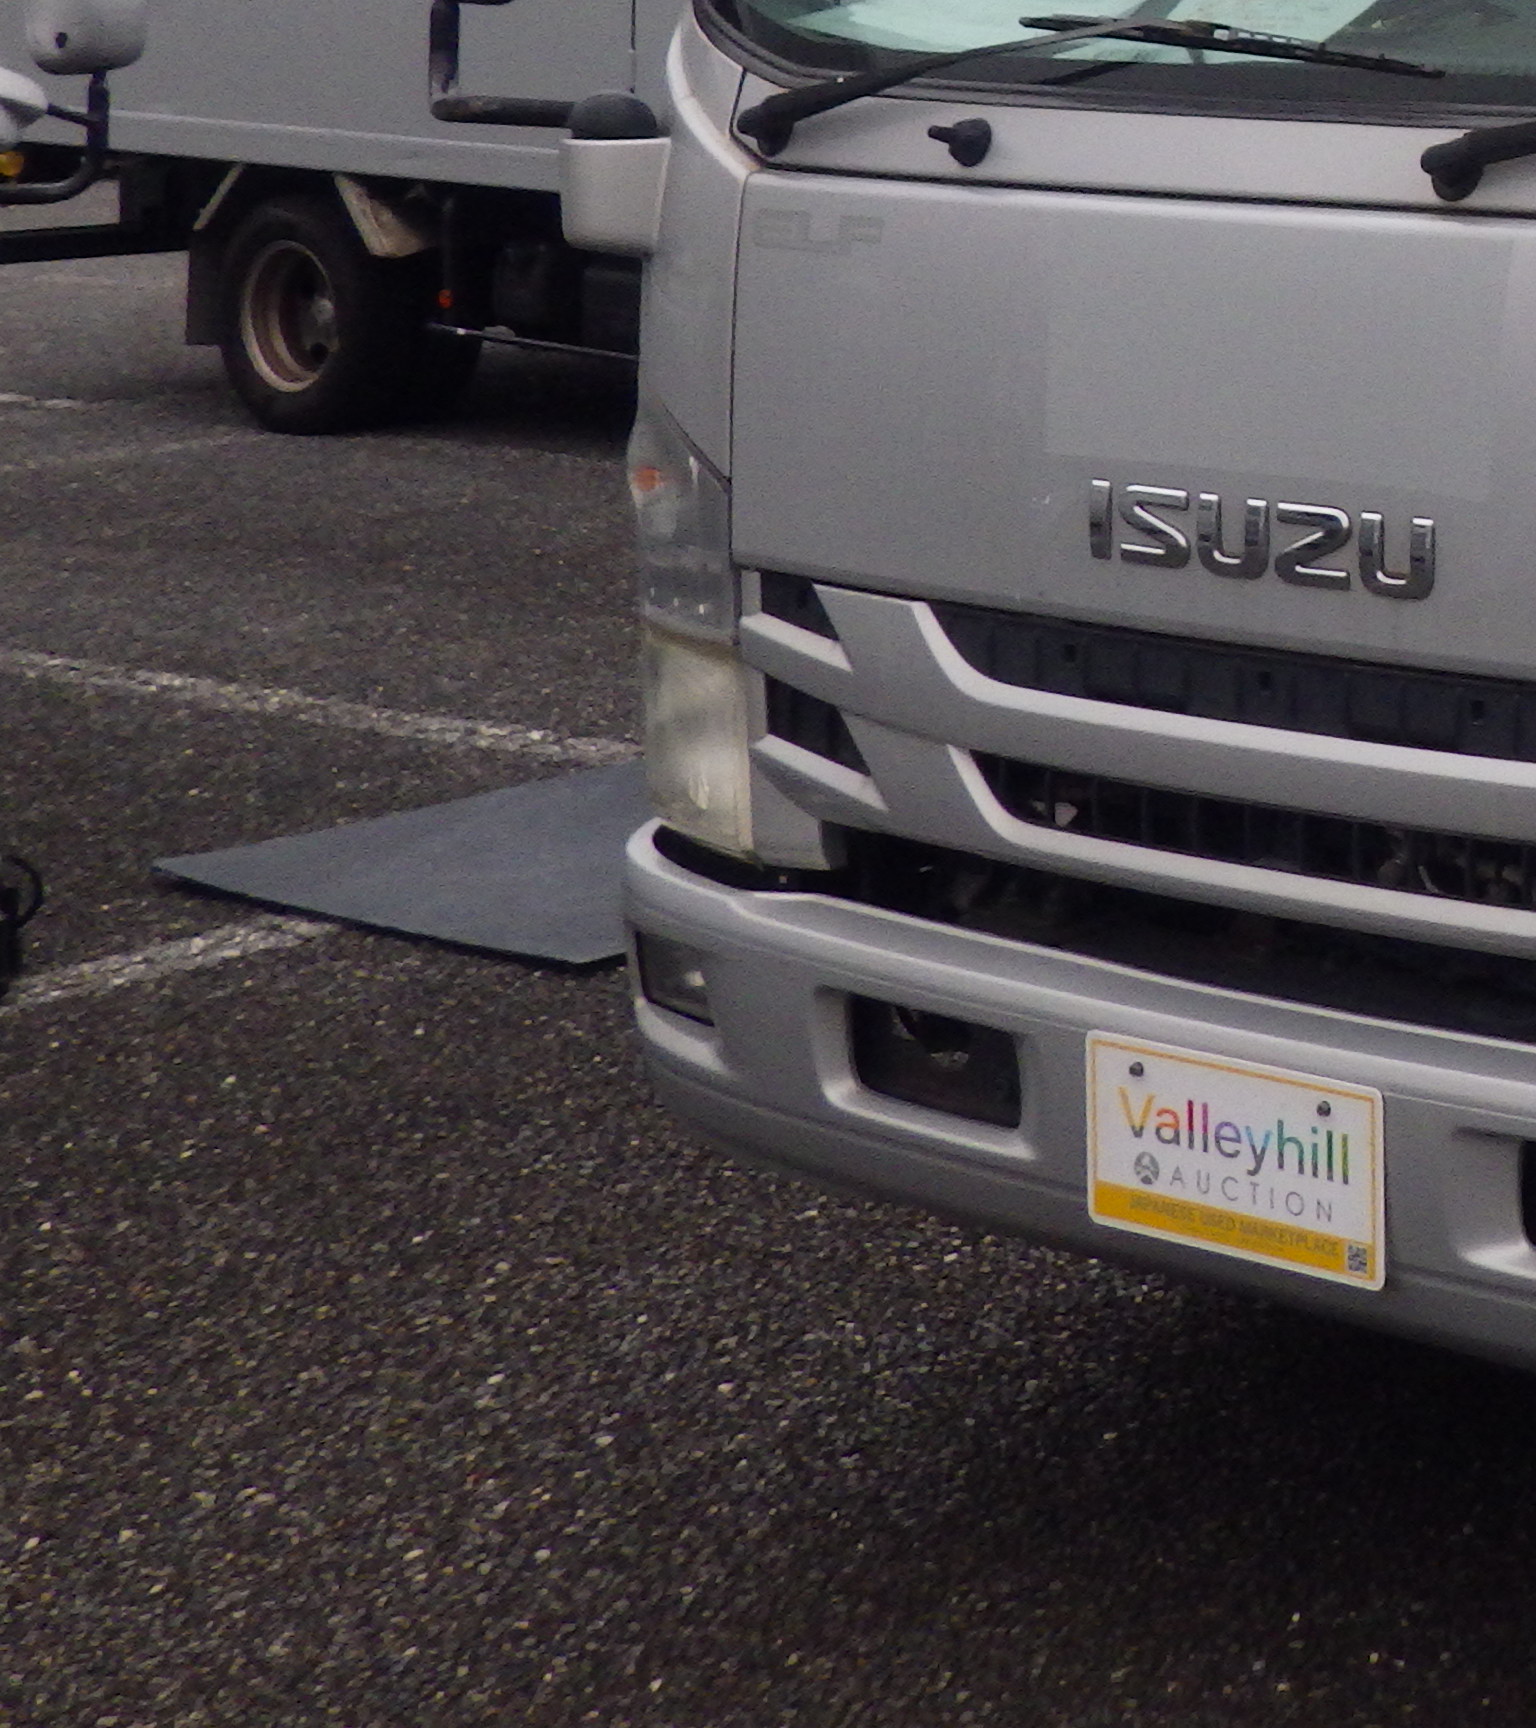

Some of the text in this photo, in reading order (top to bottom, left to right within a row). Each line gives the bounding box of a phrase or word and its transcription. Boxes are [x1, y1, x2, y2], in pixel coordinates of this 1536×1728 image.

[1089, 477, 1436, 601] ISUZU
[1117, 1085, 1350, 1186] Valleyhill
[1169, 1165, 1333, 1223] AUCTION
